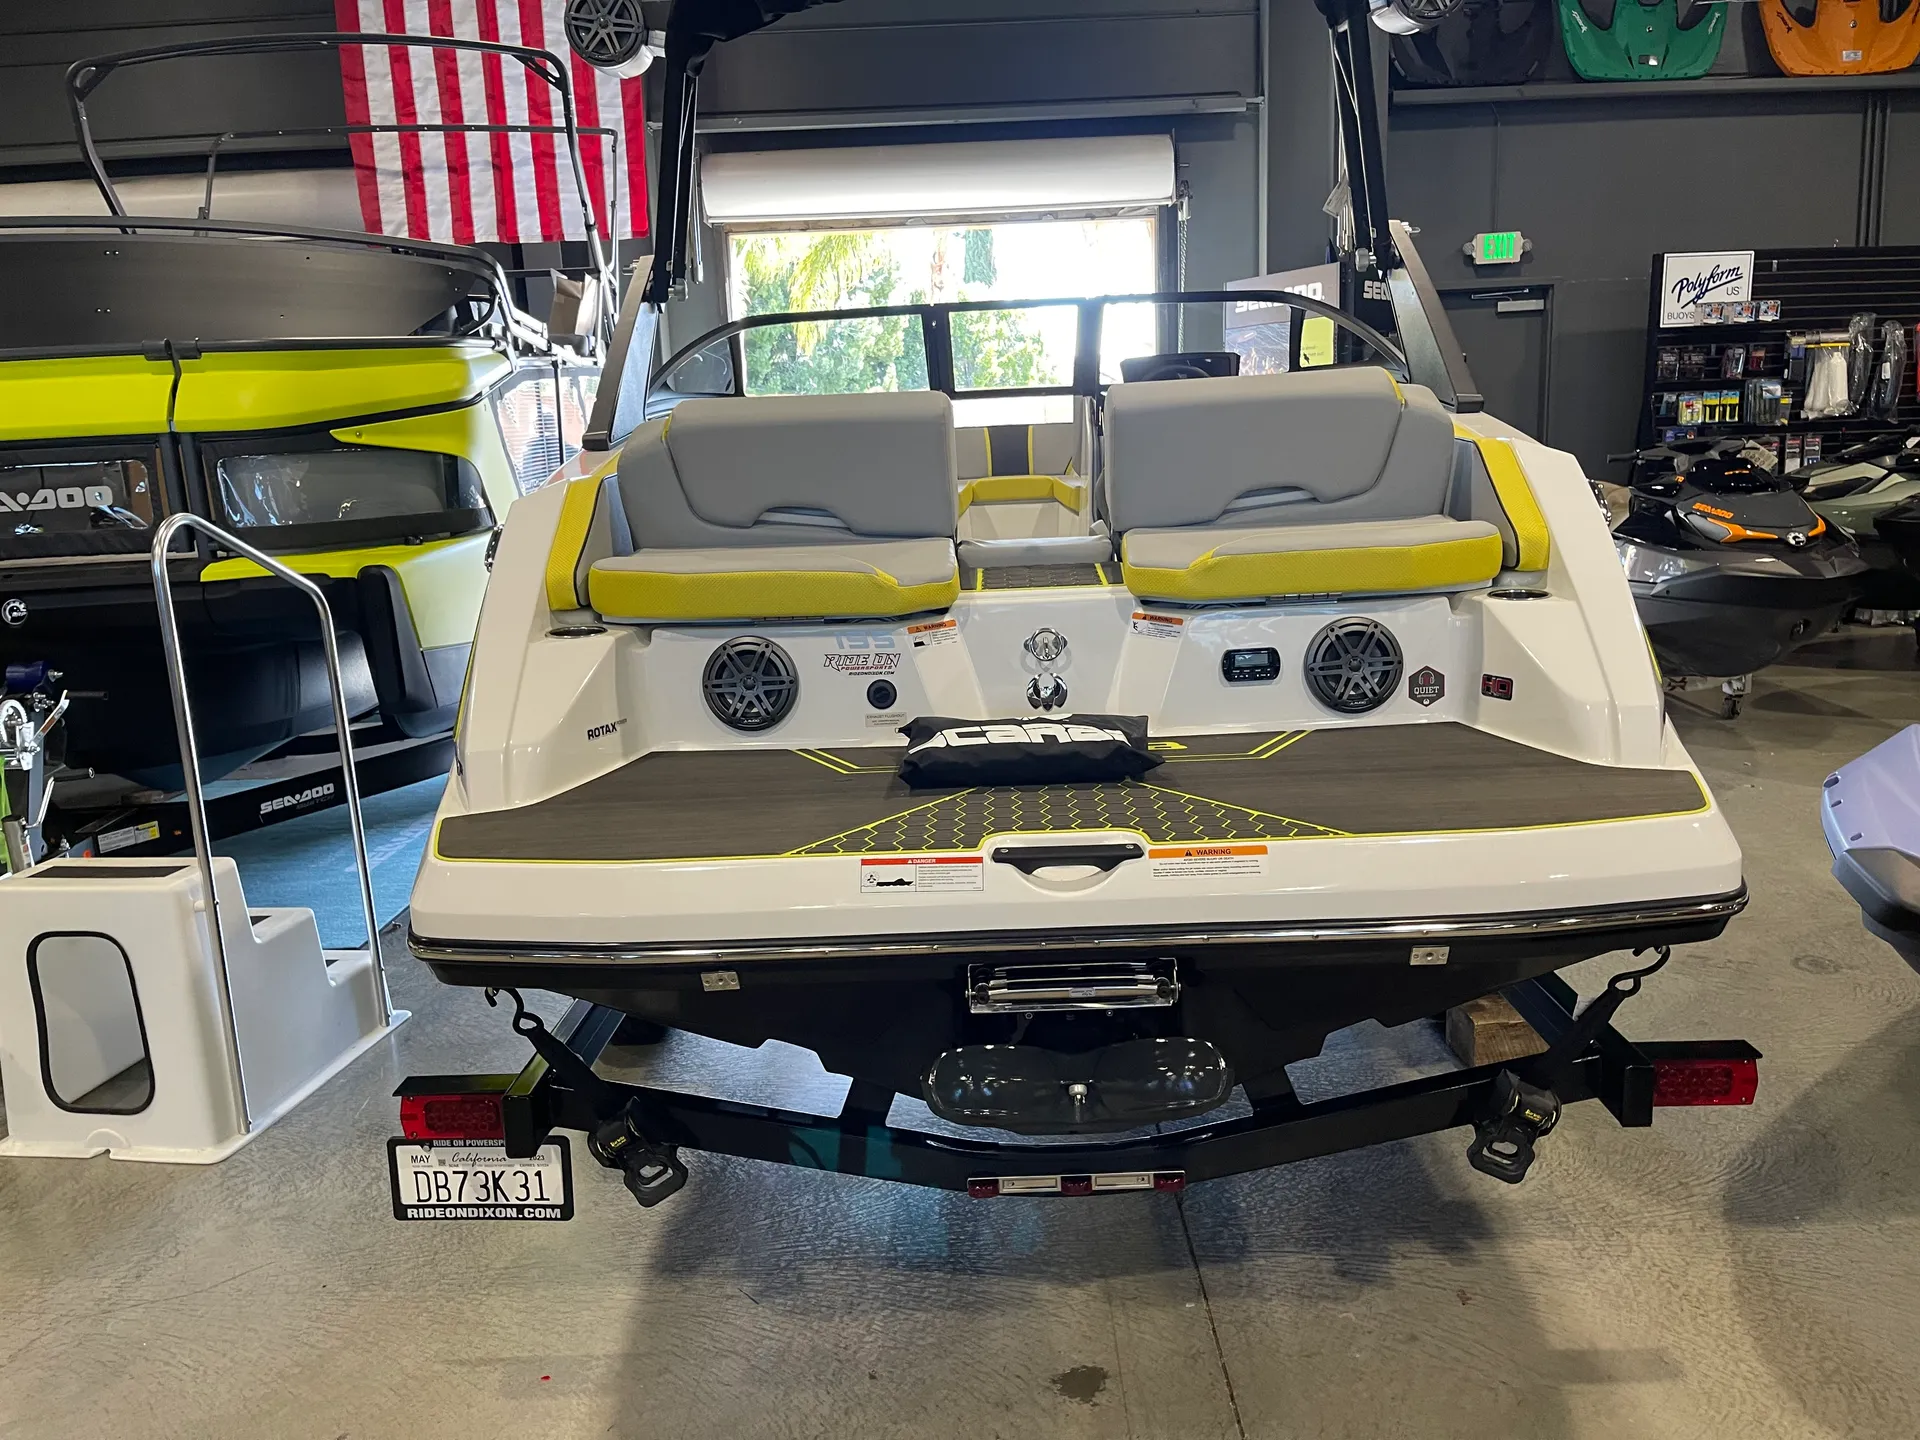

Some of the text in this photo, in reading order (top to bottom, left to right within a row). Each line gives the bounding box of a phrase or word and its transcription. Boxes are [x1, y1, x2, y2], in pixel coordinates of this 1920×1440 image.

[1484, 233, 1516, 260] EXIT
[1671, 264, 1743, 304] Polyform
[1726, 286, 1740, 296] US
[824, 652, 901, 672] RIDE ON
[1413, 686, 1440, 695] QUIET
[587, 721, 618, 740] ROTAX
[1196, 848, 1232, 857] WARNING
[433, 1139, 451, 1147] RIDE
[453, 1139, 464, 1147] ON
[410, 1155, 430, 1164] MAY
[452, 1152, 507, 1168] California
[414, 1170, 550, 1203] DB73K31
[407, 1208, 561, 1219] RIDEONDIXON.COM
